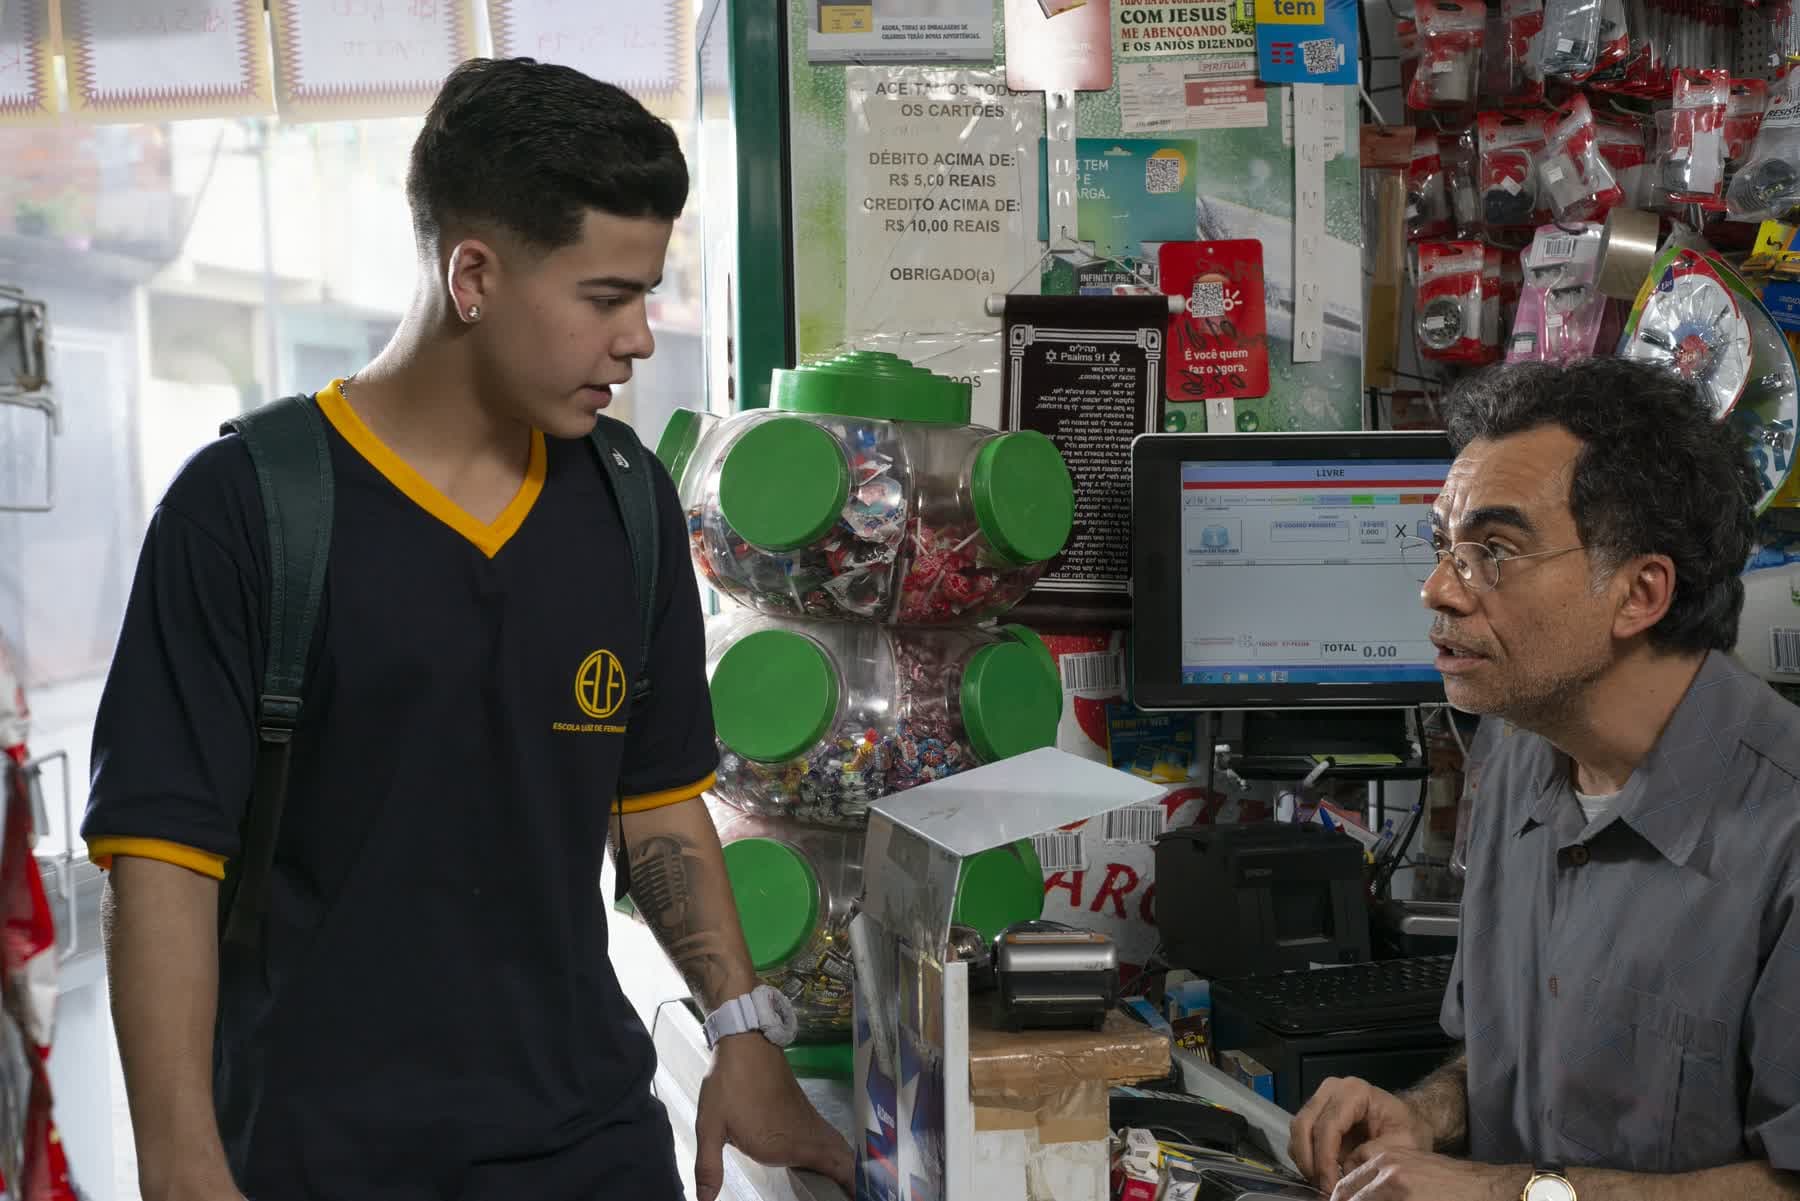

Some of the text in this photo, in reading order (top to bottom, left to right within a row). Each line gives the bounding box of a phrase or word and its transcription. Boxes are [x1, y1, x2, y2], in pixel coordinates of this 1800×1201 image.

[1273, 0, 1315, 17] tem
[1120, 7, 1227, 24] COM JESUS
[1121, 25, 1227, 39] ME ABENÇOANDO
[1122, 38, 1254, 51] E OS ANJOS DIZENDO
[901, 102, 1005, 118] OS CARTÕES
[869, 149, 1015, 166] DÉBITO ACIMA DE:
[1083, 160, 1109, 171] TEM
[889, 173, 996, 188] R$ 5,00 REAIS
[1084, 174, 1091, 184] E
[863, 198, 1021, 212] CREDITO ACIMA DE:
[885, 219, 1000, 234] R$ 10,00 REAIS
[890, 267, 995, 283] OBRIGADO(a)
[1080, 273, 1113, 282] INFINITY
[1060, 352, 1105, 361] Psalms 91
[1184, 348, 1248, 361] É você quem
[1188, 364, 1205, 374] faz
[1206, 365, 1213, 374] o
[1316, 468, 1345, 477] LIVRE
[1323, 643, 1357, 653] TOTAL
[1363, 646, 1397, 658] 0.00
[552, 721, 580, 732] ESCOLA
[594, 724, 603, 732] DE
